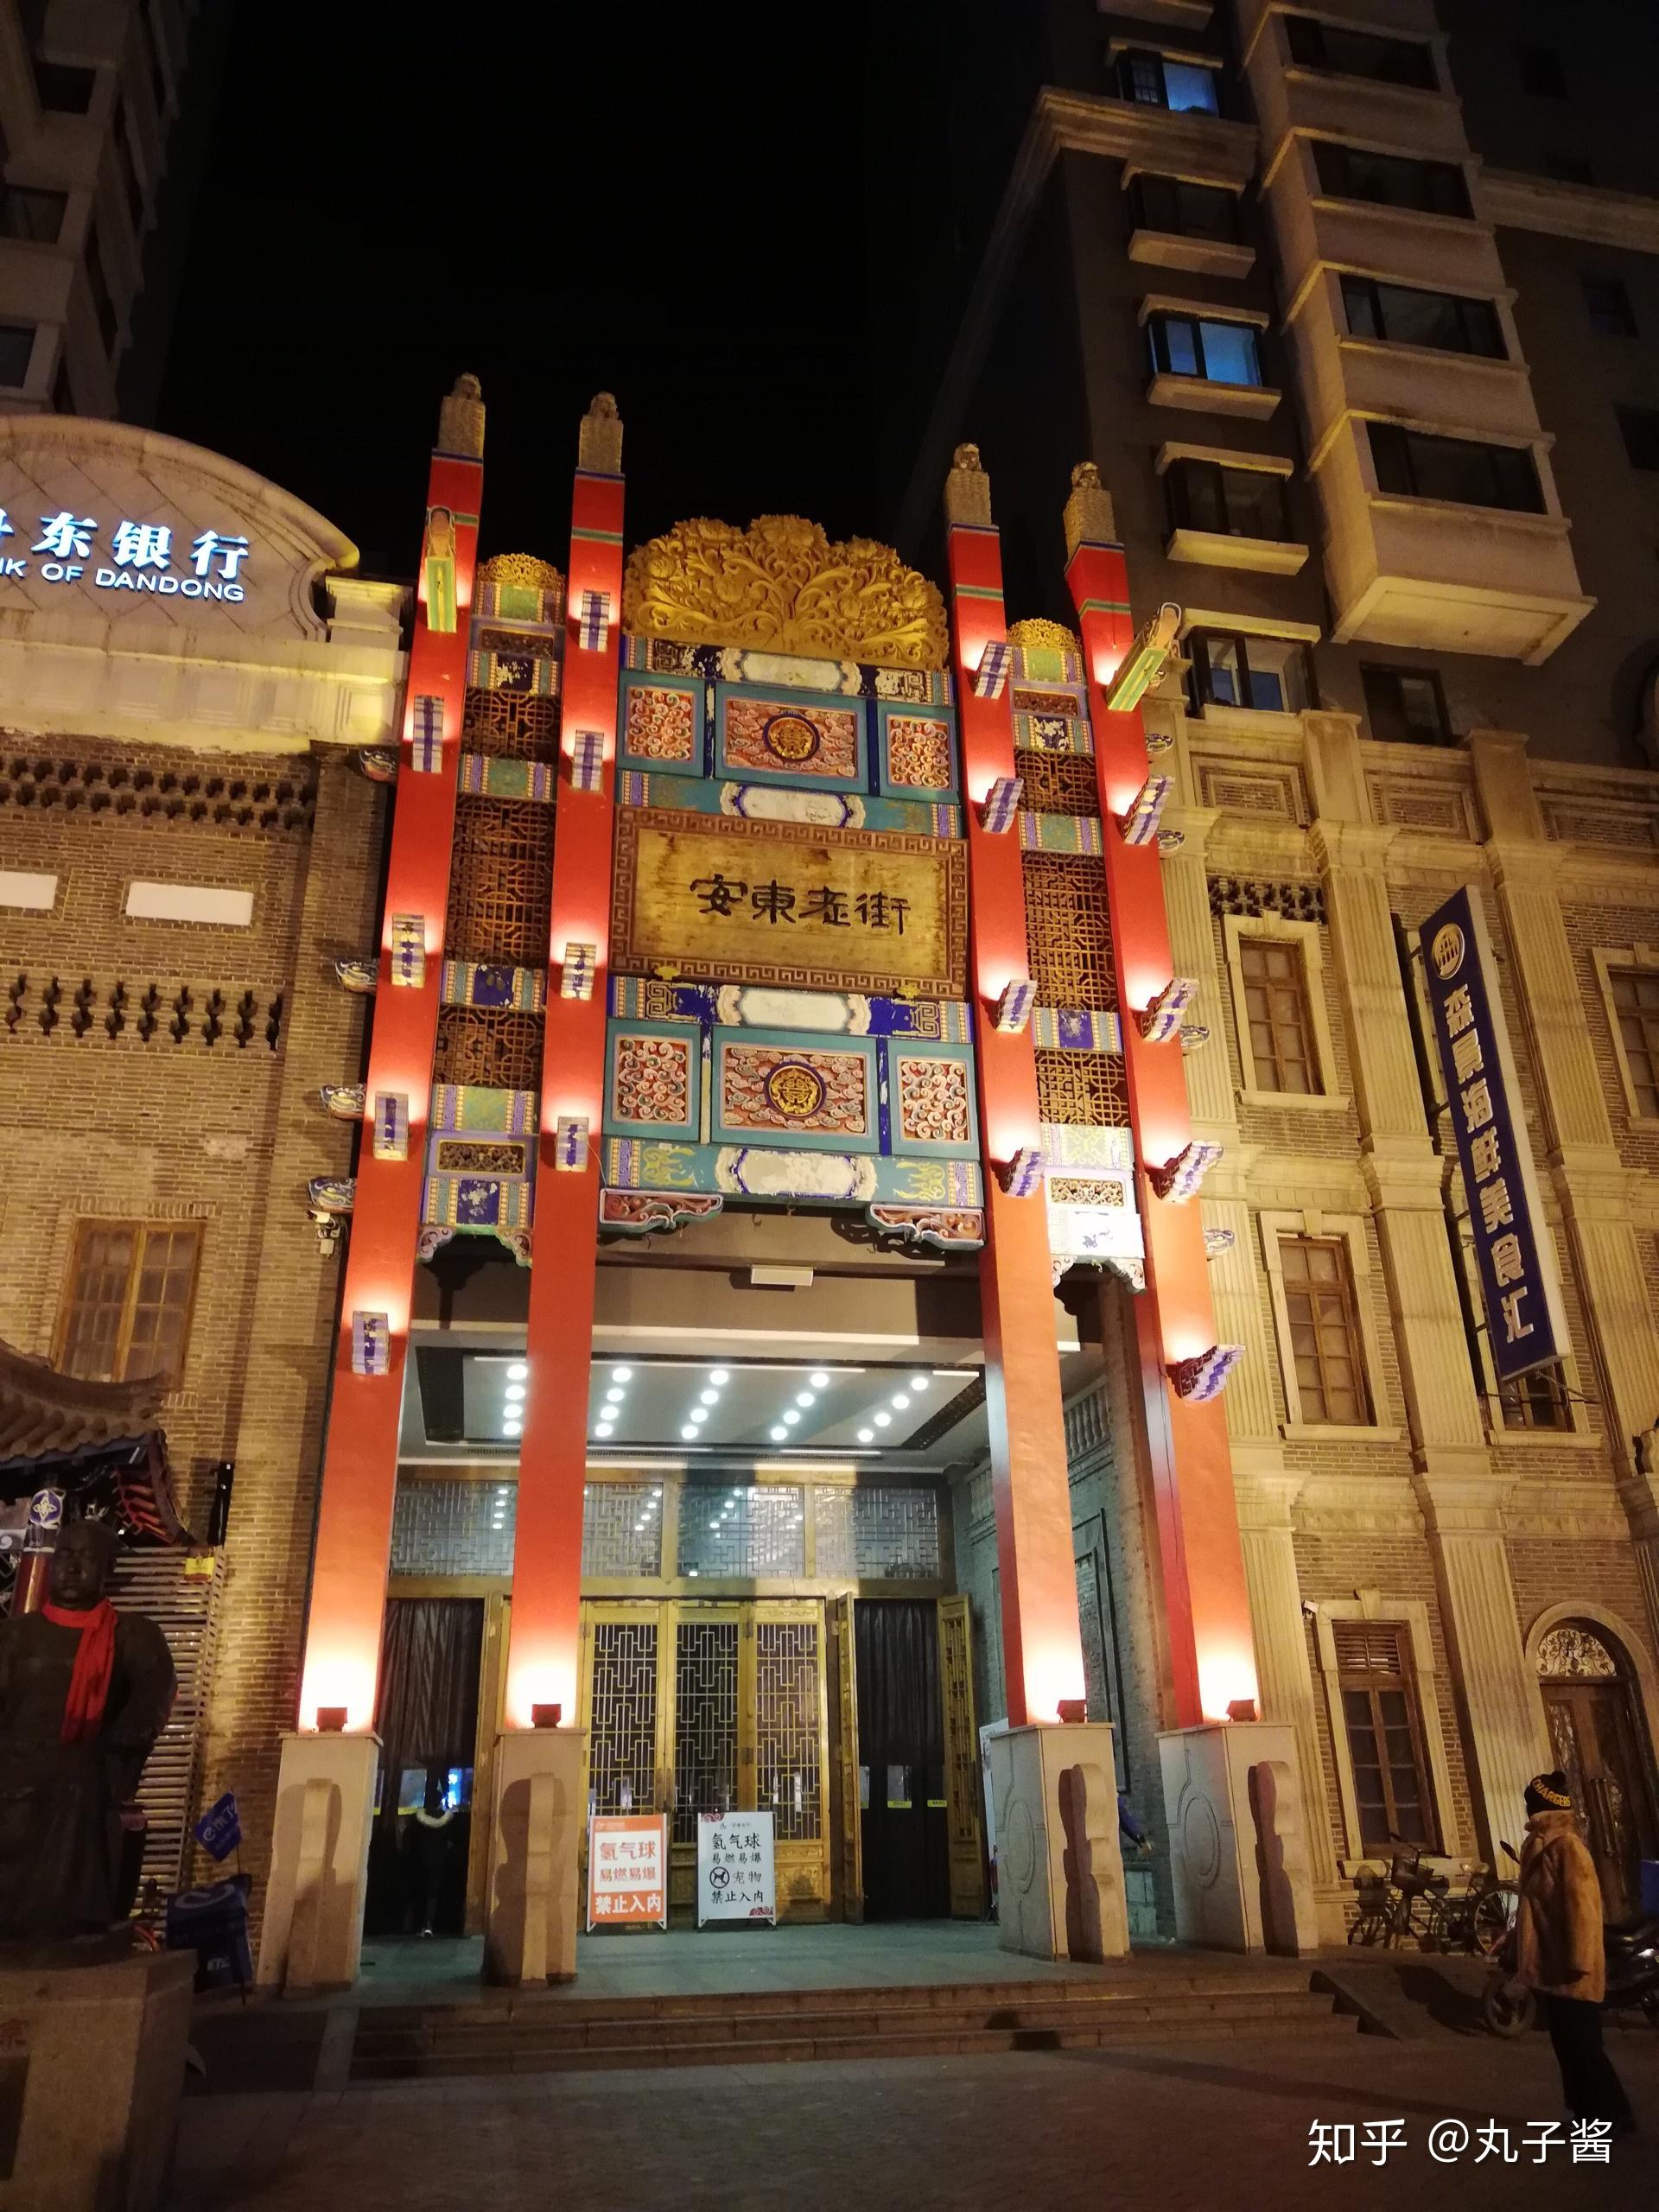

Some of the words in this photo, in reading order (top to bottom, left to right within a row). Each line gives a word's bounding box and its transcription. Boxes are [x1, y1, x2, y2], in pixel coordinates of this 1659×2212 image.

[41, 563, 84, 583] OF
[95, 568, 245, 602] DANDONG
[1444, 983, 1535, 1344] 森景海鲜美食汇
[712, 1833, 761, 1851] 氢气球
[712, 1852, 762, 1865] 易燃易爆
[600, 1866, 656, 1882] 易燃易爆
[733, 1870, 762, 1885] 宠物
[595, 1893, 662, 1916] 禁止入内
[711, 1890, 764, 1905] 禁止入内
